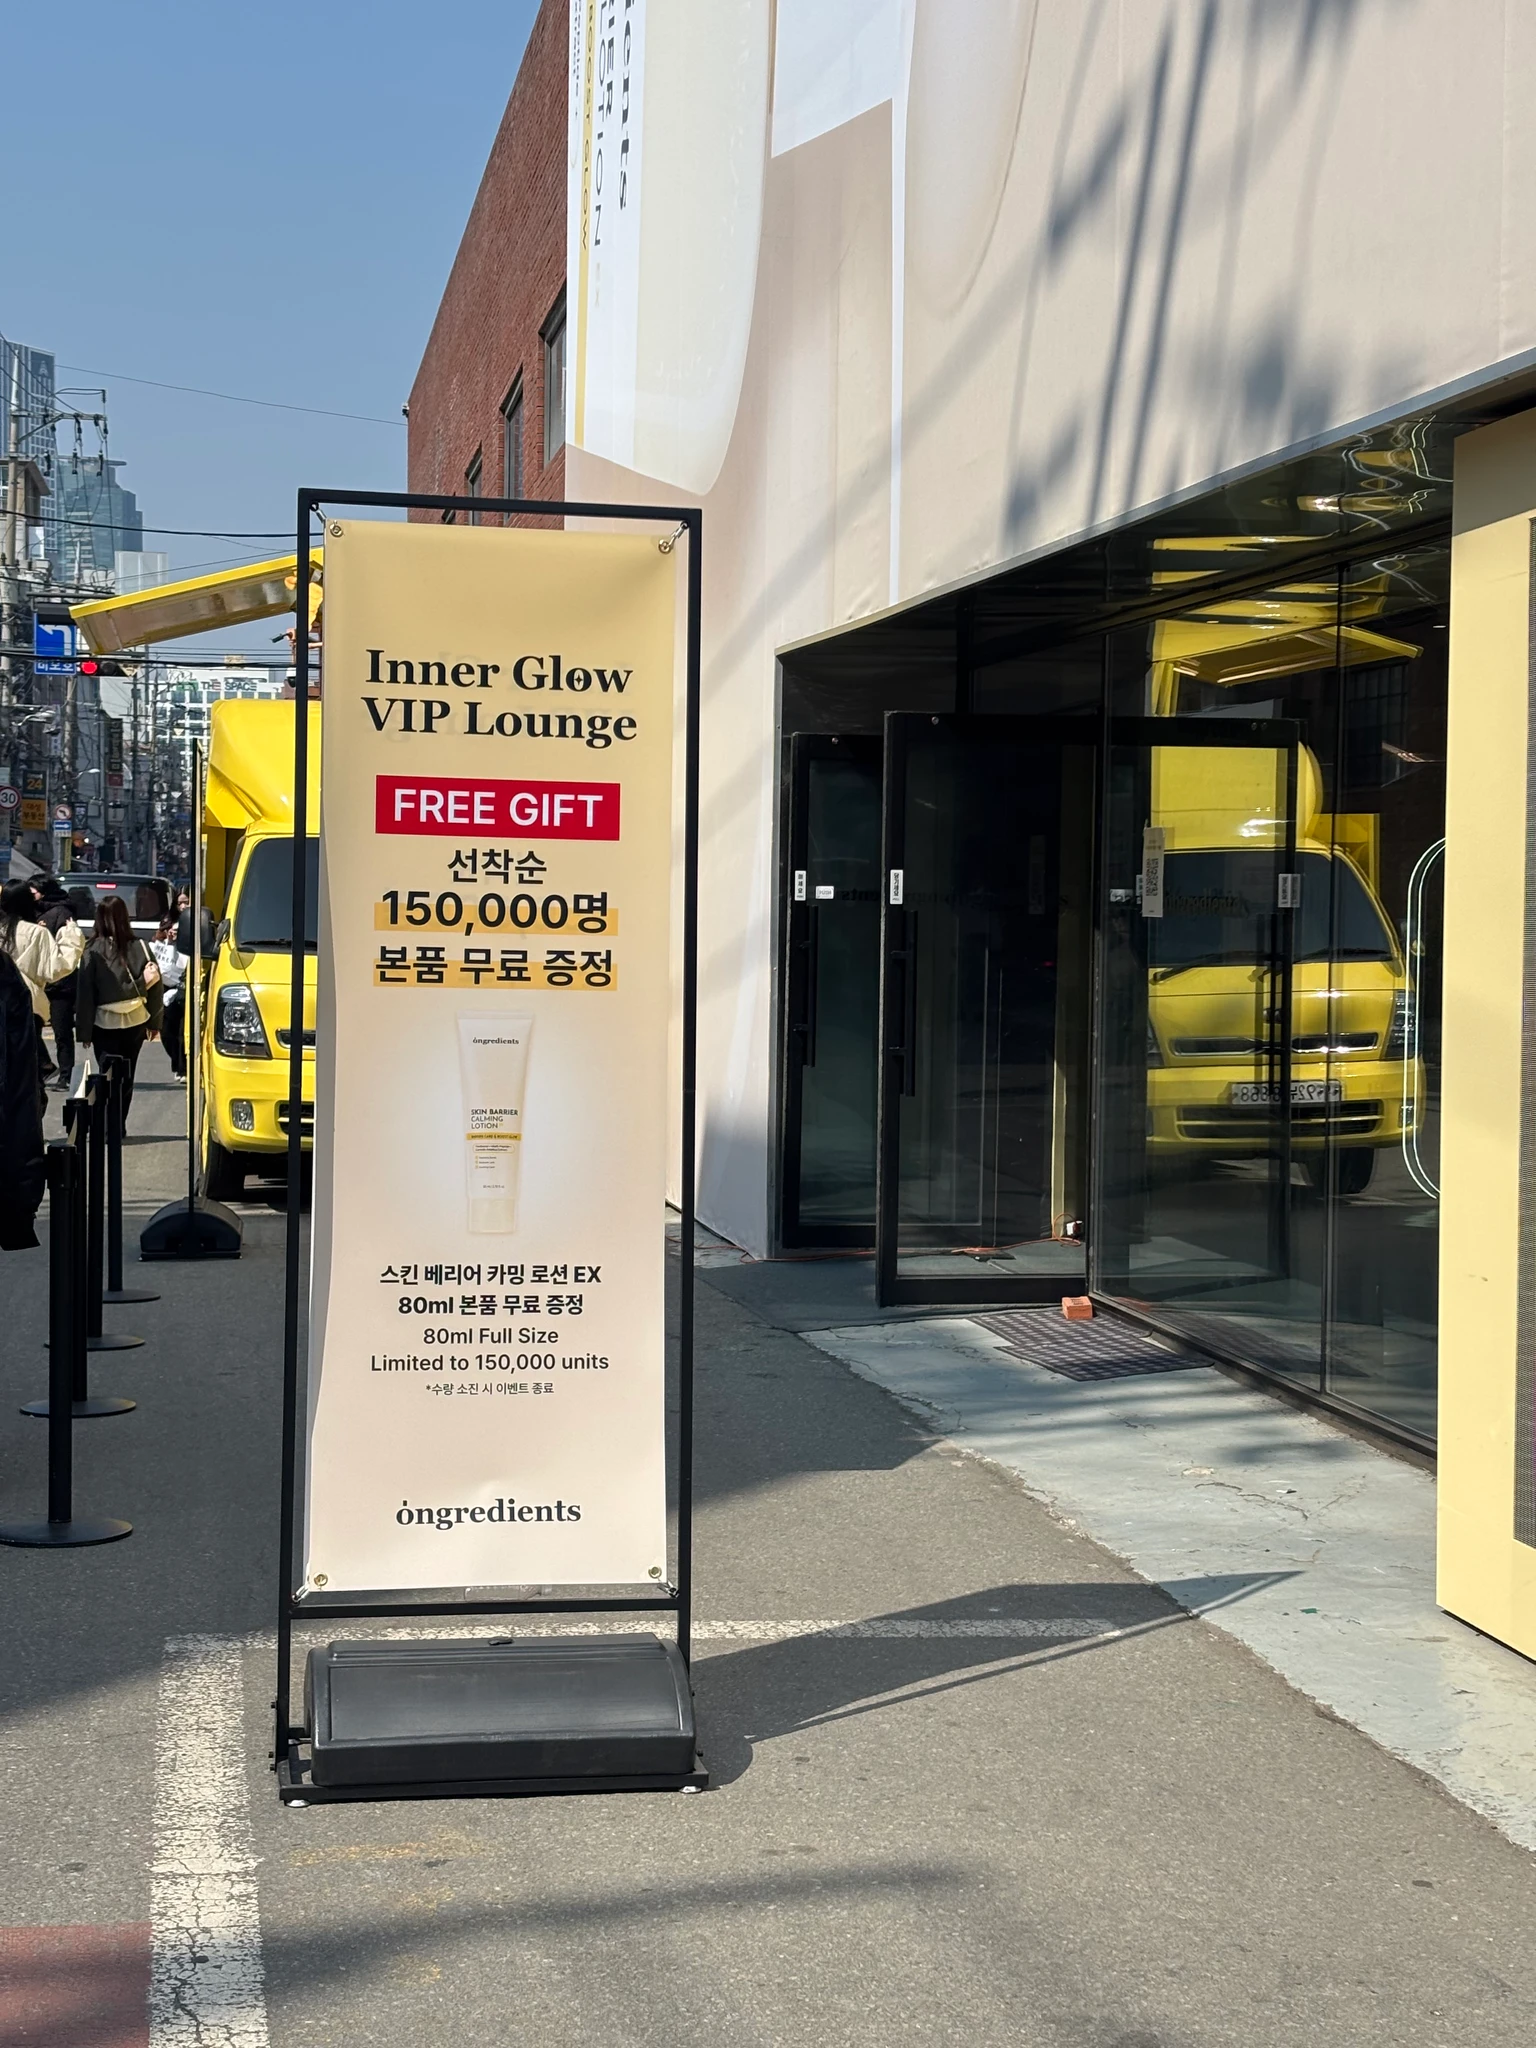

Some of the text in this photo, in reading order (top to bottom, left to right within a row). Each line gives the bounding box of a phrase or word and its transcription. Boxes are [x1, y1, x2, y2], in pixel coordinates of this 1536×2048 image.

[594, 0, 607, 246] LOTION
[365, 649, 634, 693] Inner Glow
[201, 681, 257, 691] THE SPACE
[360, 696, 638, 749] VIP Lounge
[27, 779, 43, 790] 24
[1, 792, 16, 804] 30
[394, 788, 603, 827] FREE GIFT
[447, 848, 547, 884] 선착순
[382, 891, 608, 936] 150,000명
[375, 945, 612, 988] 본품 무료 증정
[380, 1264, 602, 1285] 스킨 베리어 카밍 로션 EX
[398, 1294, 584, 1315] 80ml 본품 무료 증정
[423, 1327, 559, 1344] 80ml Full Size
[371, 1353, 609, 1374] Limited to 150,000 units
[457, 1383, 479, 1395] 소진
[482, 1382, 493, 1395] 시
[496, 1382, 530, 1395] 이벤트
[532, 1382, 555, 1394] 종료
